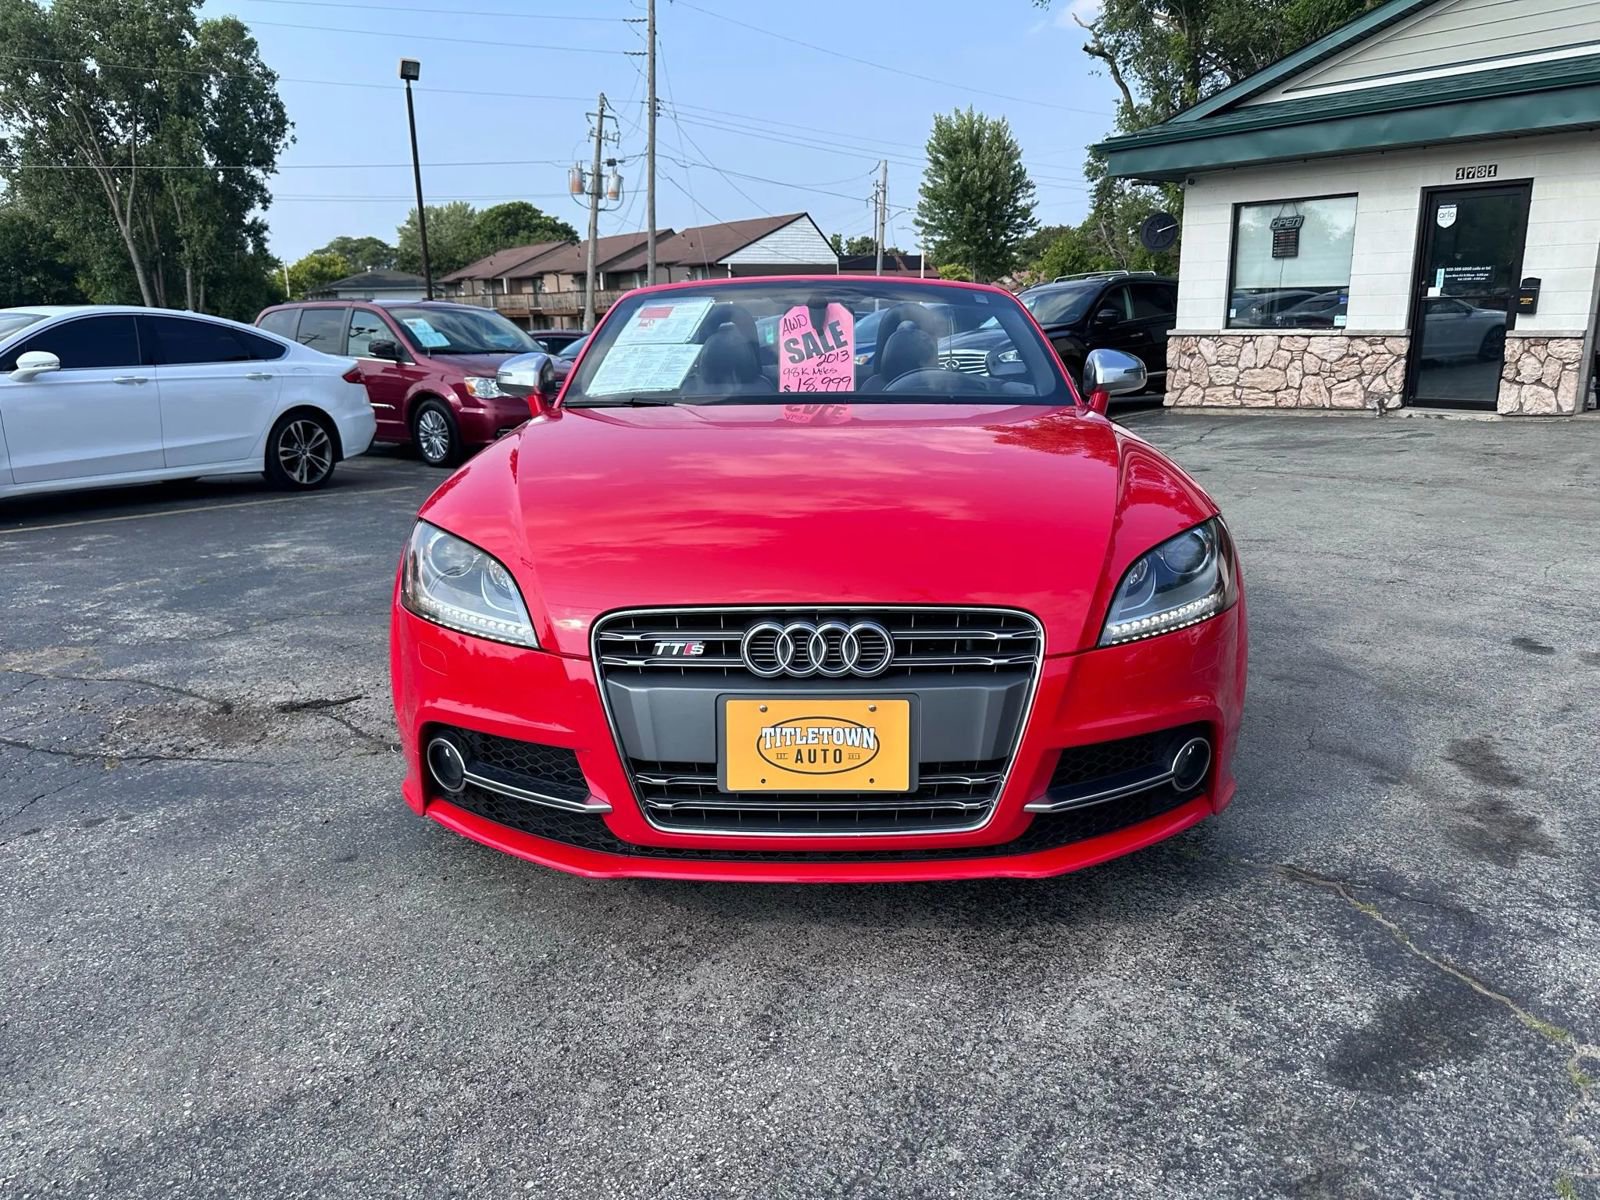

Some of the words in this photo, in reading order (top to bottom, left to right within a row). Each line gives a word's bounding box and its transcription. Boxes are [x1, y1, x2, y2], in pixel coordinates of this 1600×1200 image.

[1456, 165, 1497, 179] 1731
[1271, 217, 1302, 228] OPEN
[1438, 210, 1455, 219] arlo
[782, 314, 808, 336] AWD
[784, 320, 848, 364] SALE
[816, 350, 850, 367] 2013
[760, 727, 876, 750] TITLETOWN
[794, 748, 843, 764] AUTO
